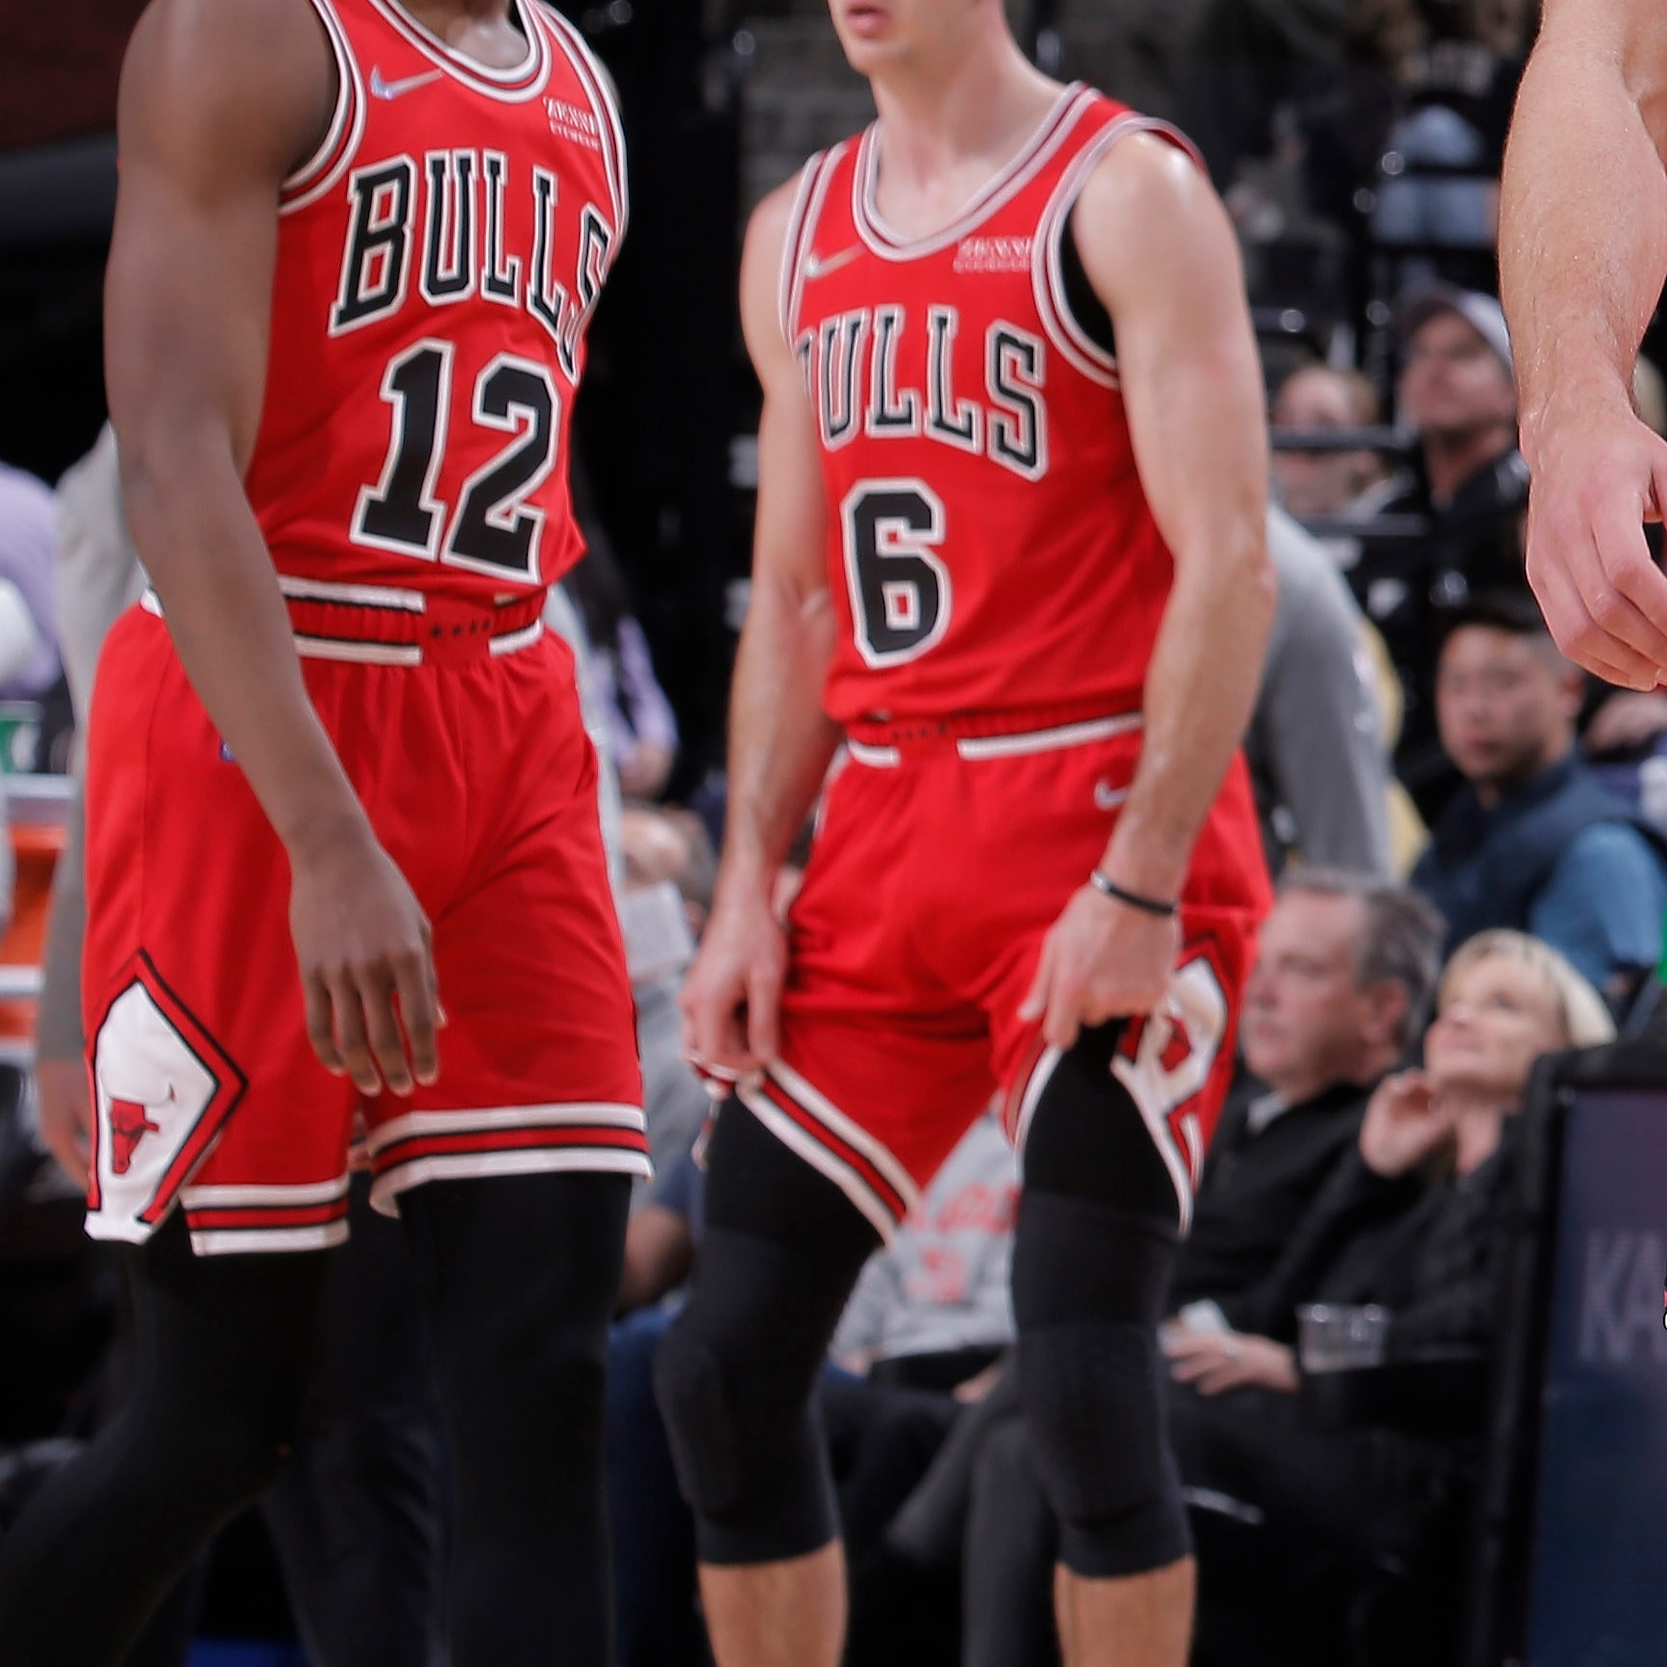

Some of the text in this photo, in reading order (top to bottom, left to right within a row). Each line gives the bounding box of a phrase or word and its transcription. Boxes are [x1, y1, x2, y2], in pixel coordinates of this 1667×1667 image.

[327, 147, 615, 387] BULLS
[352, 337, 563, 584] 12
[794, 302, 1050, 482] ULLS
[840, 477, 950, 670] 6
